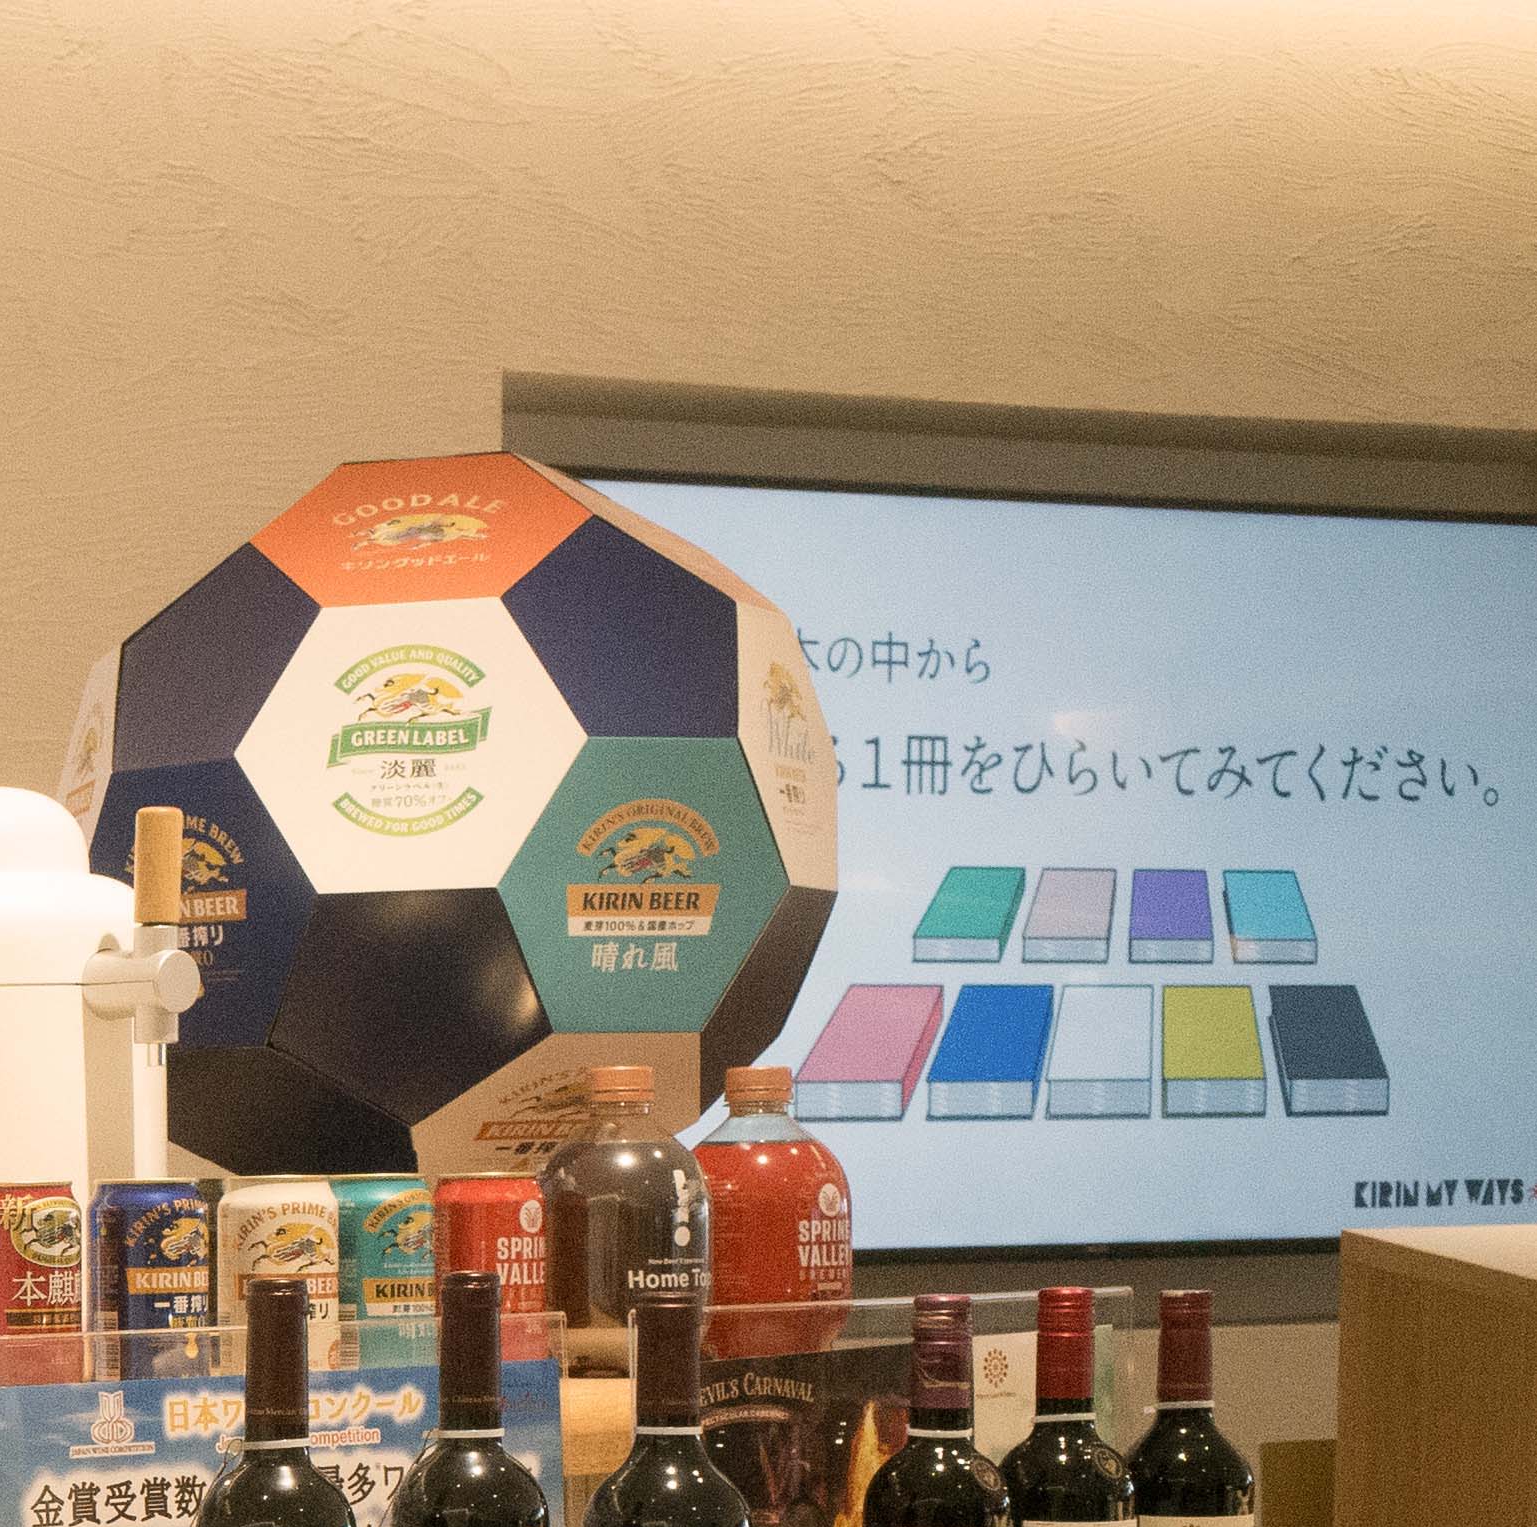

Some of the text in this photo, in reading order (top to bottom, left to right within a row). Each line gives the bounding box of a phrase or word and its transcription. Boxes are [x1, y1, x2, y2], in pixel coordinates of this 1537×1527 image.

[411, 649, 434, 662] AND
[350, 727, 470, 748] GREEN LABEL
[380, 758, 437, 780] 淡麗
[194, 896, 240, 918] BEER
[582, 891, 701, 912] KIRIN BEER
[590, 940, 679, 973] 晴れ風
[1353, 1178, 1525, 1209] KIRIN MY WAYS
[281, 1202, 326, 1219] PRIME
[135, 1271, 191, 1289] KIRIN
[627, 1269, 690, 1290] Home
[375, 1283, 424, 1300] KIRIN
[30, 1474, 207, 1527] 金賞受賞数
